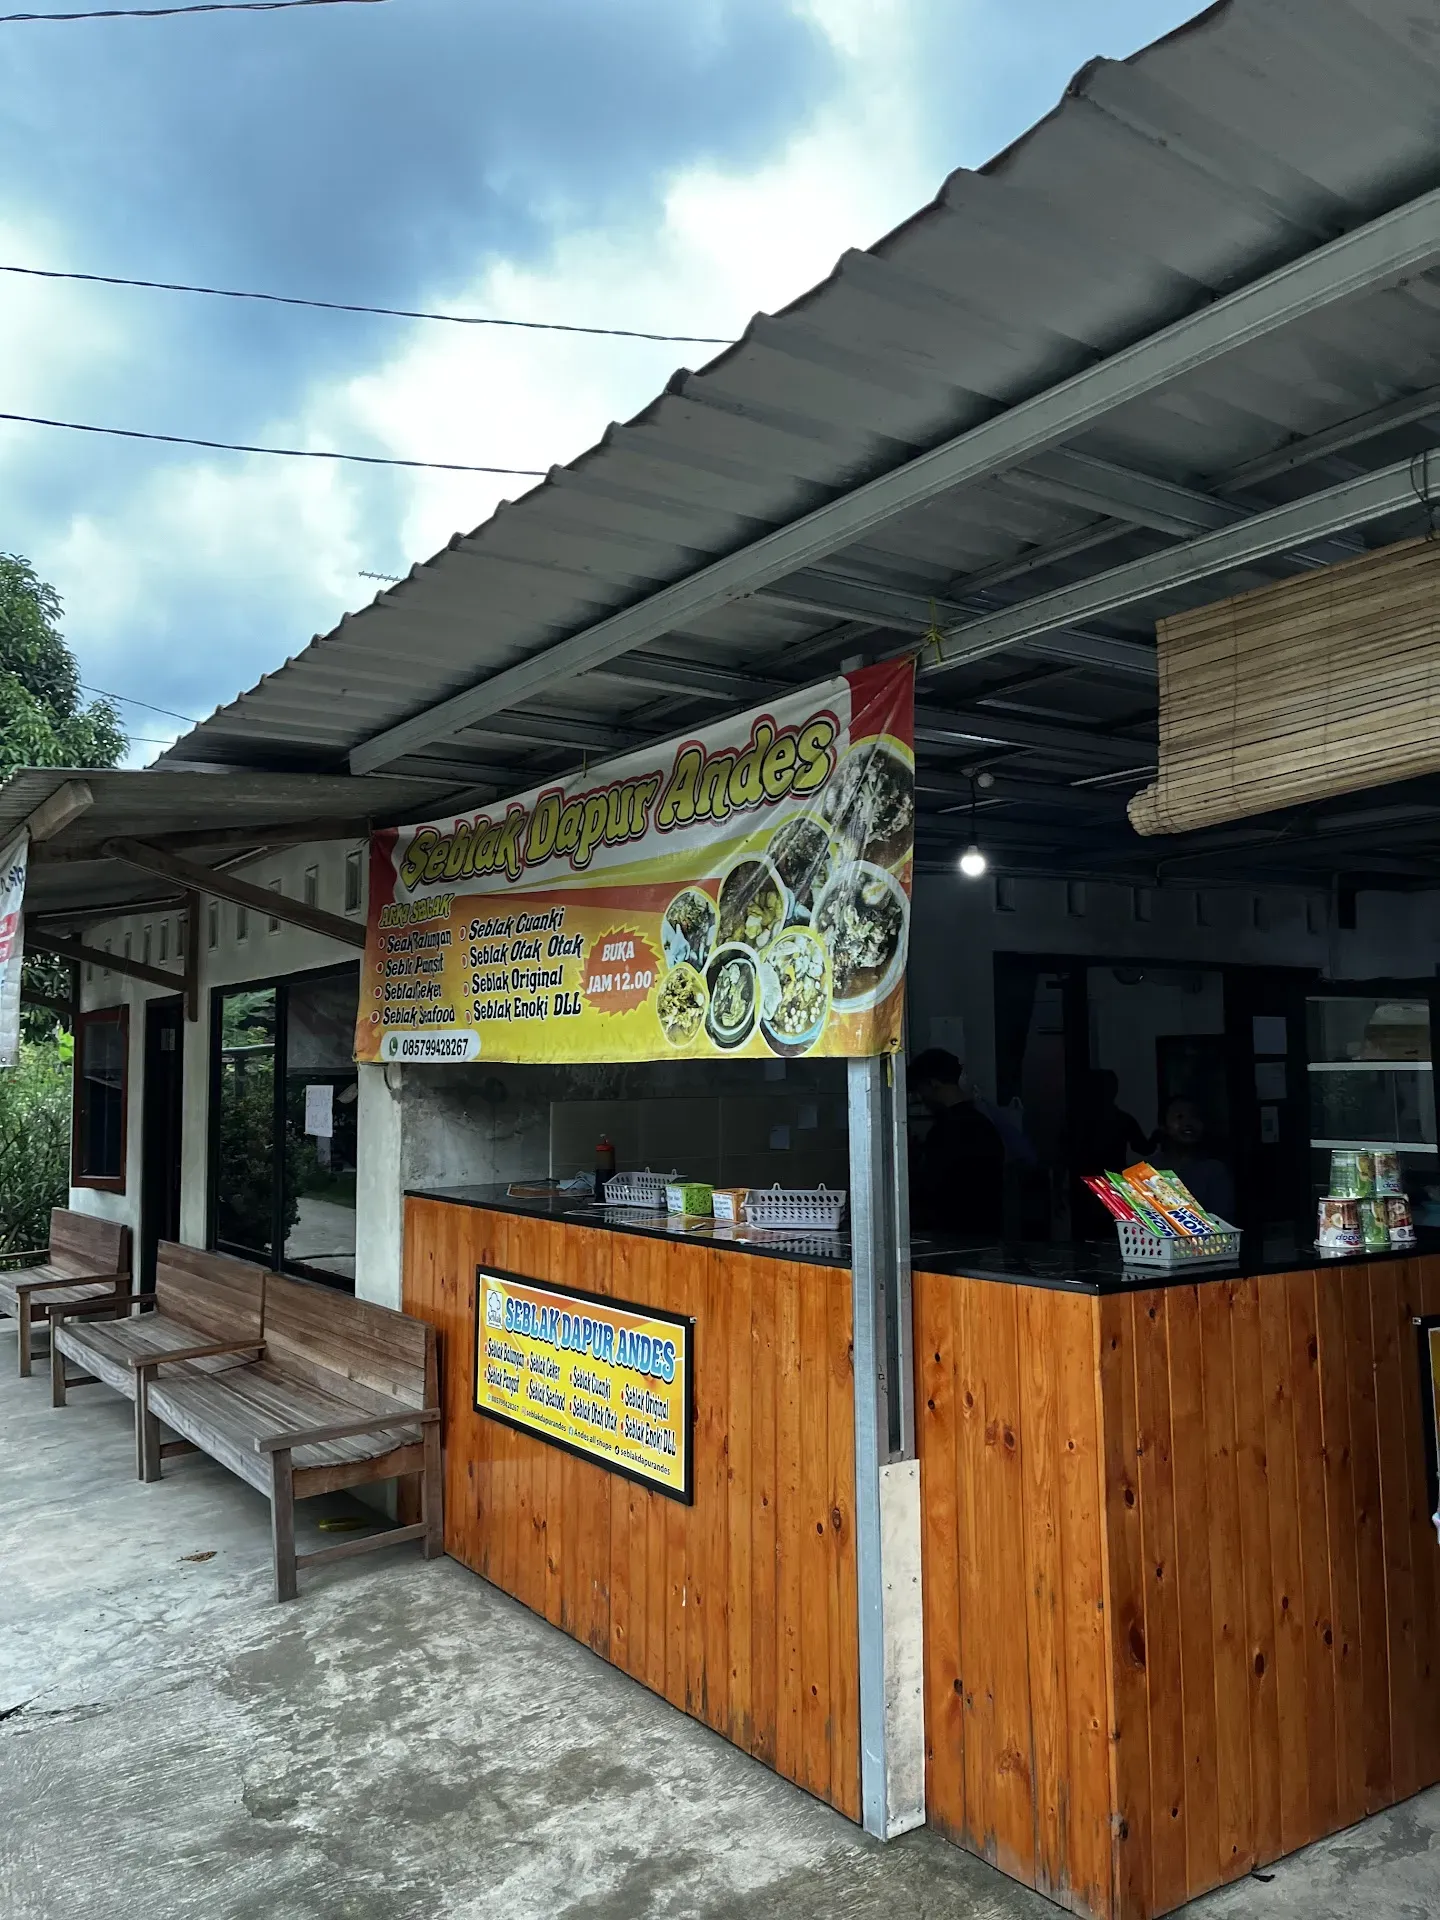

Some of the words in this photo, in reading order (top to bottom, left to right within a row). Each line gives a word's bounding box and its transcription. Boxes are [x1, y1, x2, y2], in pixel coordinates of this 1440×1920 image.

[401, 806, 526, 891] Seblak
[526, 772, 664, 869] Dapur
[656, 715, 838, 830] Andes
[468, 918, 514, 942] Seblak
[515, 907, 565, 934] Cuanki
[470, 944, 509, 968] Seblak
[510, 937, 543, 963] Otak
[547, 932, 584, 958] Otak
[601, 940, 635, 962] BUKA
[472, 969, 511, 995] Seblak
[511, 964, 564, 994] Original
[586, 972, 613, 995] JAM
[613, 970, 652, 992] 12.00
[382, 1006, 418, 1028] Seblak
[473, 998, 512, 1022] Seblak
[514, 995, 548, 1020] Enoki
[553, 991, 582, 1016] DLL
[402, 1038, 469, 1057] 085799428267
[505, 1297, 560, 1351] SEBLAK
[561, 1313, 616, 1368] DAPUR
[615, 1328, 677, 1385] ANDES
[528, 1351, 546, 1378] Seblak
[528, 1378, 546, 1407] Seblak
[573, 1366, 592, 1396] Seblak
[572, 1395, 591, 1427] Seblak
[625, 1383, 646, 1415] Seblak
[645, 1391, 669, 1422] Original
[624, 1413, 646, 1448] Seblak
[645, 1422, 662, 1455] Enoki
[573, 1428, 589, 1442] Andes
[620, 1450, 671, 1476] seblakdapurandes
